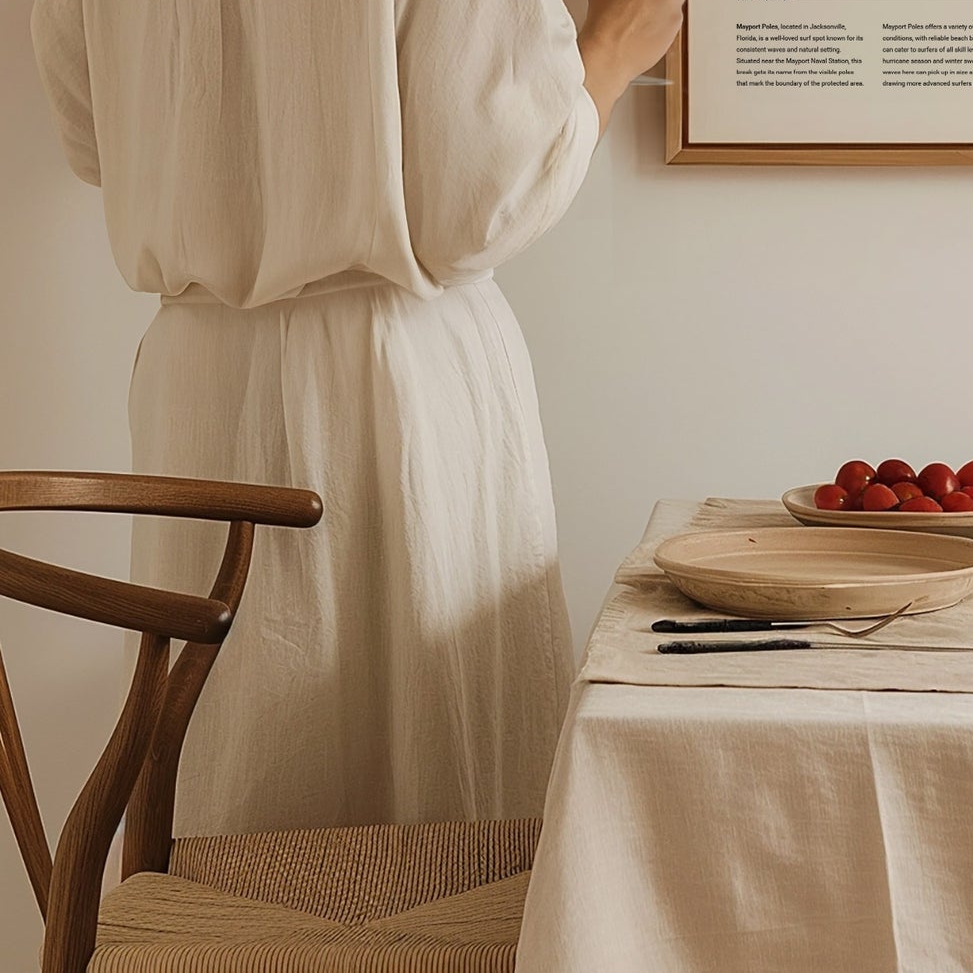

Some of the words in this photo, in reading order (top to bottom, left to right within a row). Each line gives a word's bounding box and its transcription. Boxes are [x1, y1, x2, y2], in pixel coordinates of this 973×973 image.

[736, 23, 761, 31] Mayport
[882, 23, 907, 31] Mayport
[948, 23, 967, 31] variety
[812, 35, 825, 43] spot
[820, 46, 841, 54] setting.
[786, 58, 810, 66] Mayport
[775, 80, 802, 88] boundary
[821, 80, 849, 88] protected
[882, 80, 905, 88] drawing
